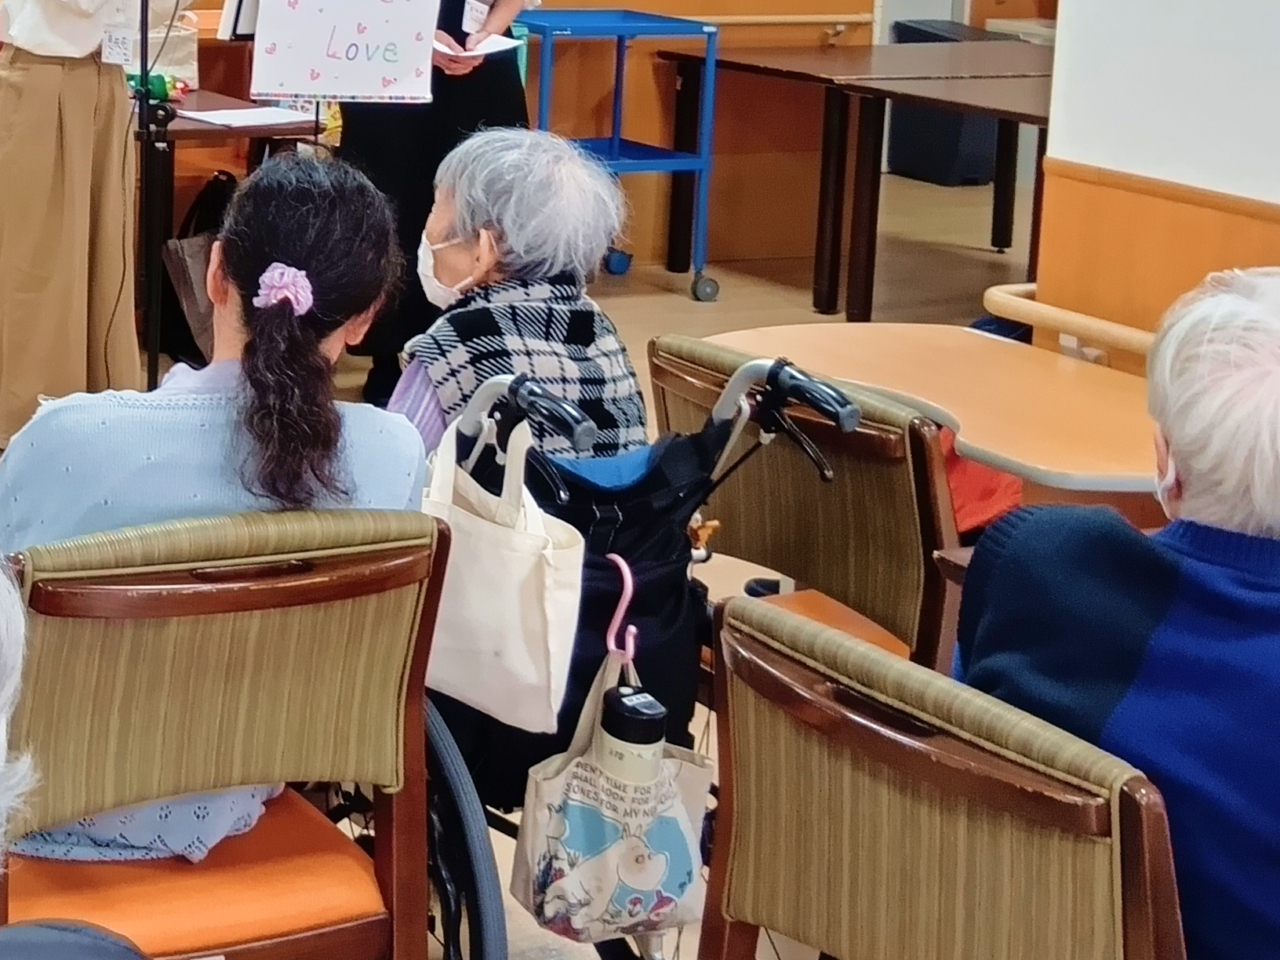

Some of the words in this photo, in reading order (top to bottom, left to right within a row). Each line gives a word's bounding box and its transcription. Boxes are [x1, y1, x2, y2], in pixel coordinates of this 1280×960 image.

[601, 785, 625, 803] LOOK
[606, 777, 628, 794] TIME
[623, 808, 639, 818] MY
